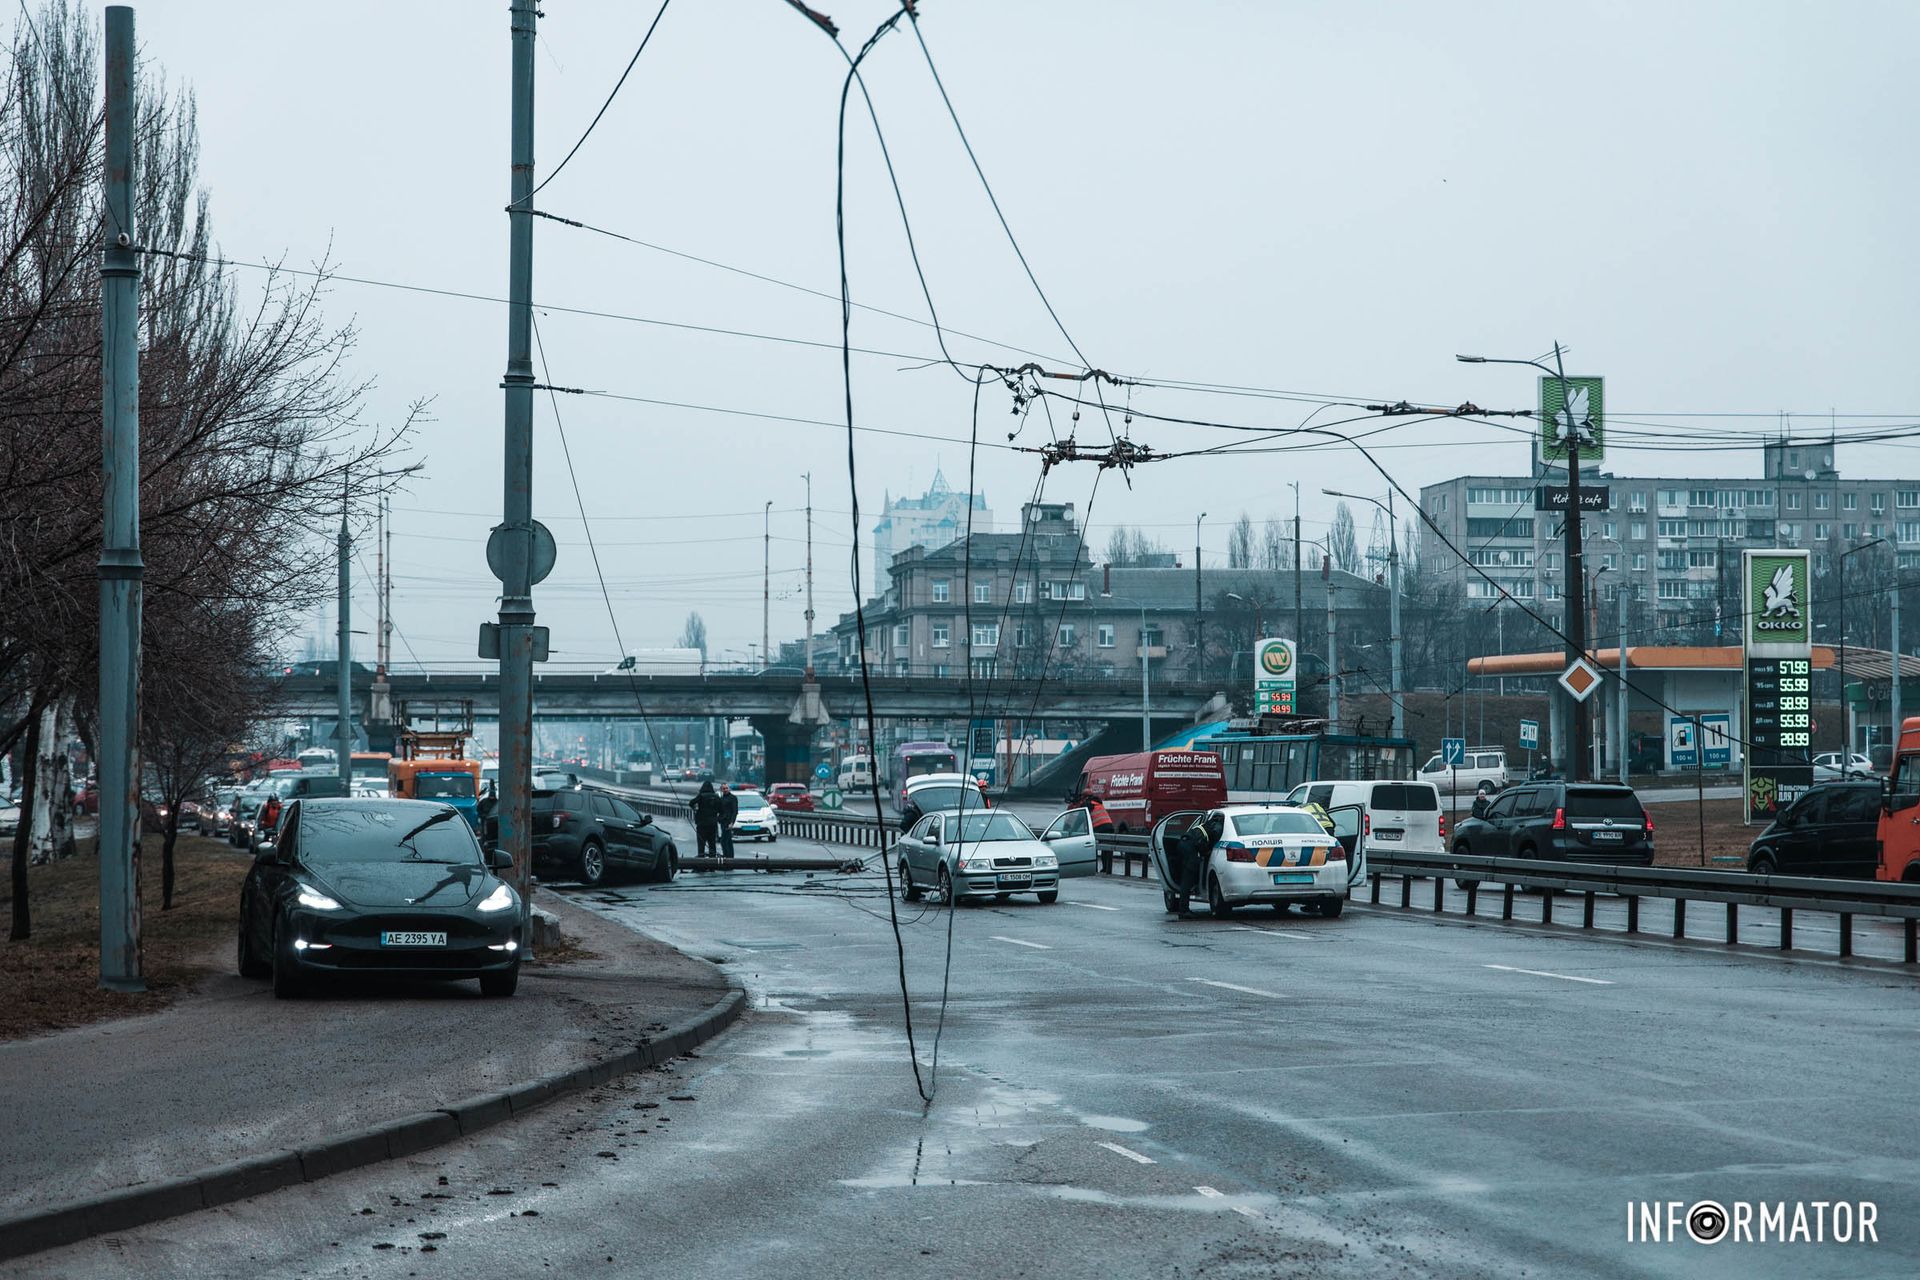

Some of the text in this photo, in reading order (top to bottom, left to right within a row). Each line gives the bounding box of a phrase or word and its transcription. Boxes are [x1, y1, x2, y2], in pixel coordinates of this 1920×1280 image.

[1584, 494, 1602, 506] cafe
[1758, 621, 1803, 630] OKKO
[1780, 661, 1808, 674] 57.99
[1780, 678, 1809, 692] 55.99
[1780, 696, 1809, 711] 58.99
[1780, 714, 1809, 728] 55.99
[1780, 732, 1809, 746] 28.99
[1158, 754, 1217, 764] Früchte Frank
[1111, 774, 1129, 787] Früchte
[1129, 773, 1144, 786] Frank
[388, 934, 445, 944] AE 2395 YA
